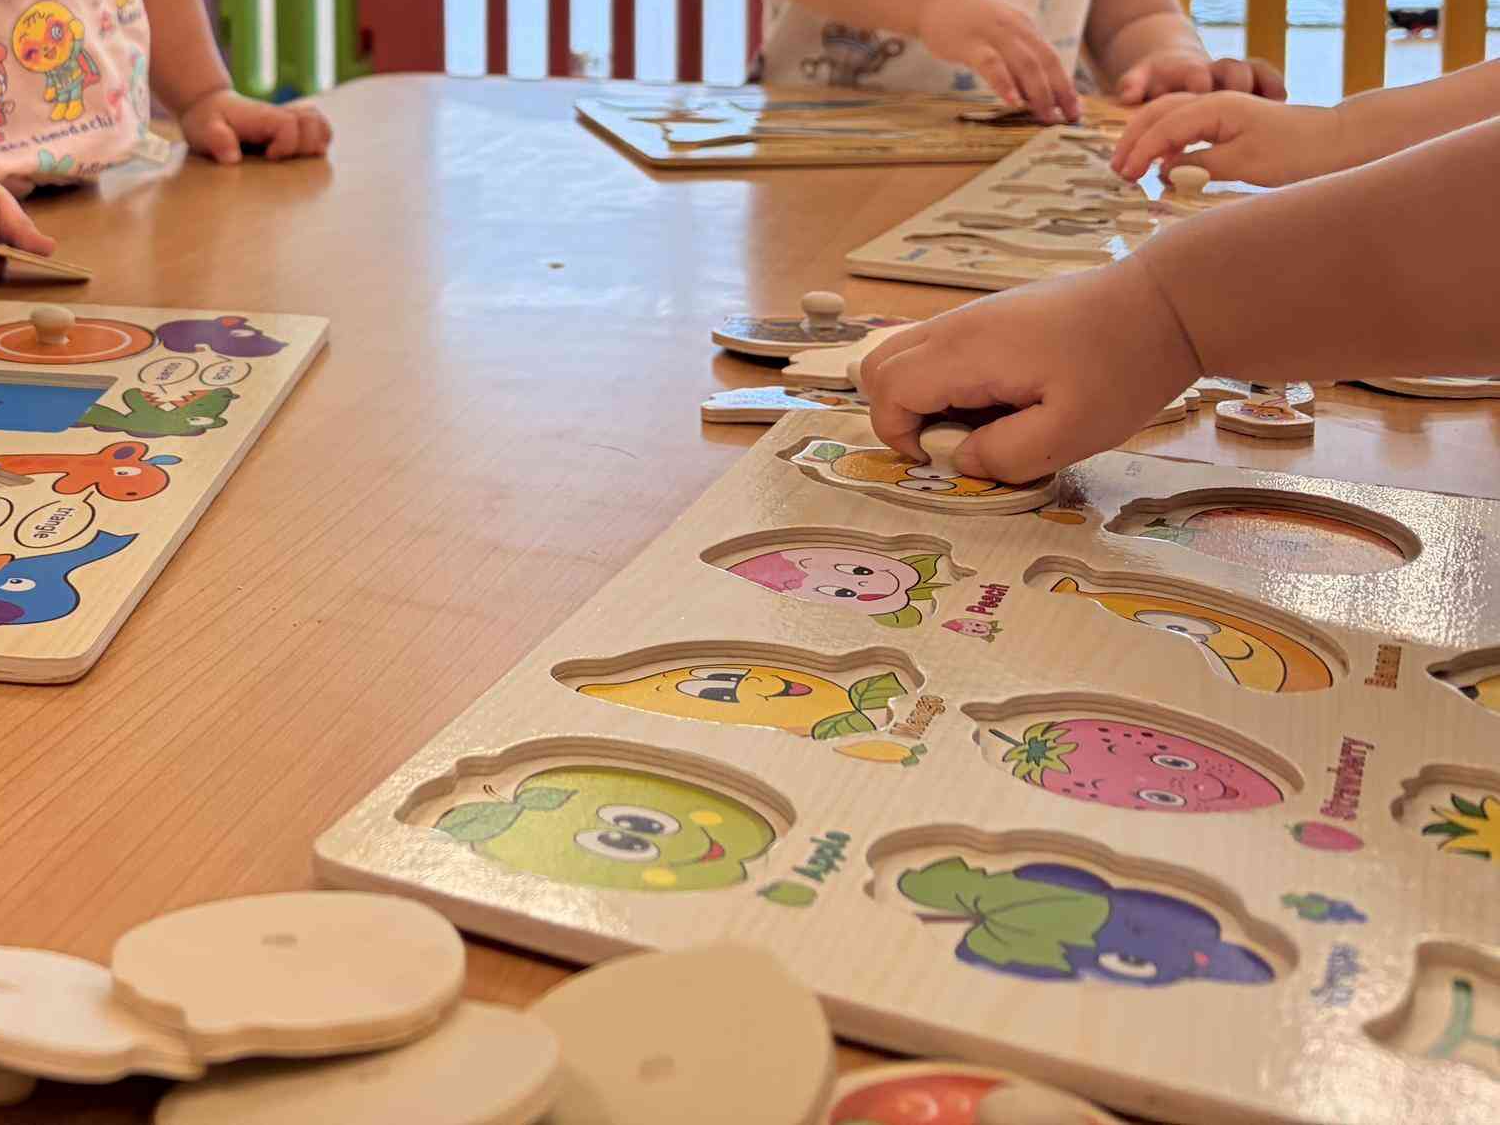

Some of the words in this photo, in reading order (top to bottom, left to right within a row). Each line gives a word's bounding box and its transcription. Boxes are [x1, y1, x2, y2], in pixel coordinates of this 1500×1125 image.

[33, 506, 76, 539] triangle
[965, 583, 1011, 615] Peach
[1319, 735, 1375, 821] Strawberry
[791, 831, 851, 884] Apple
